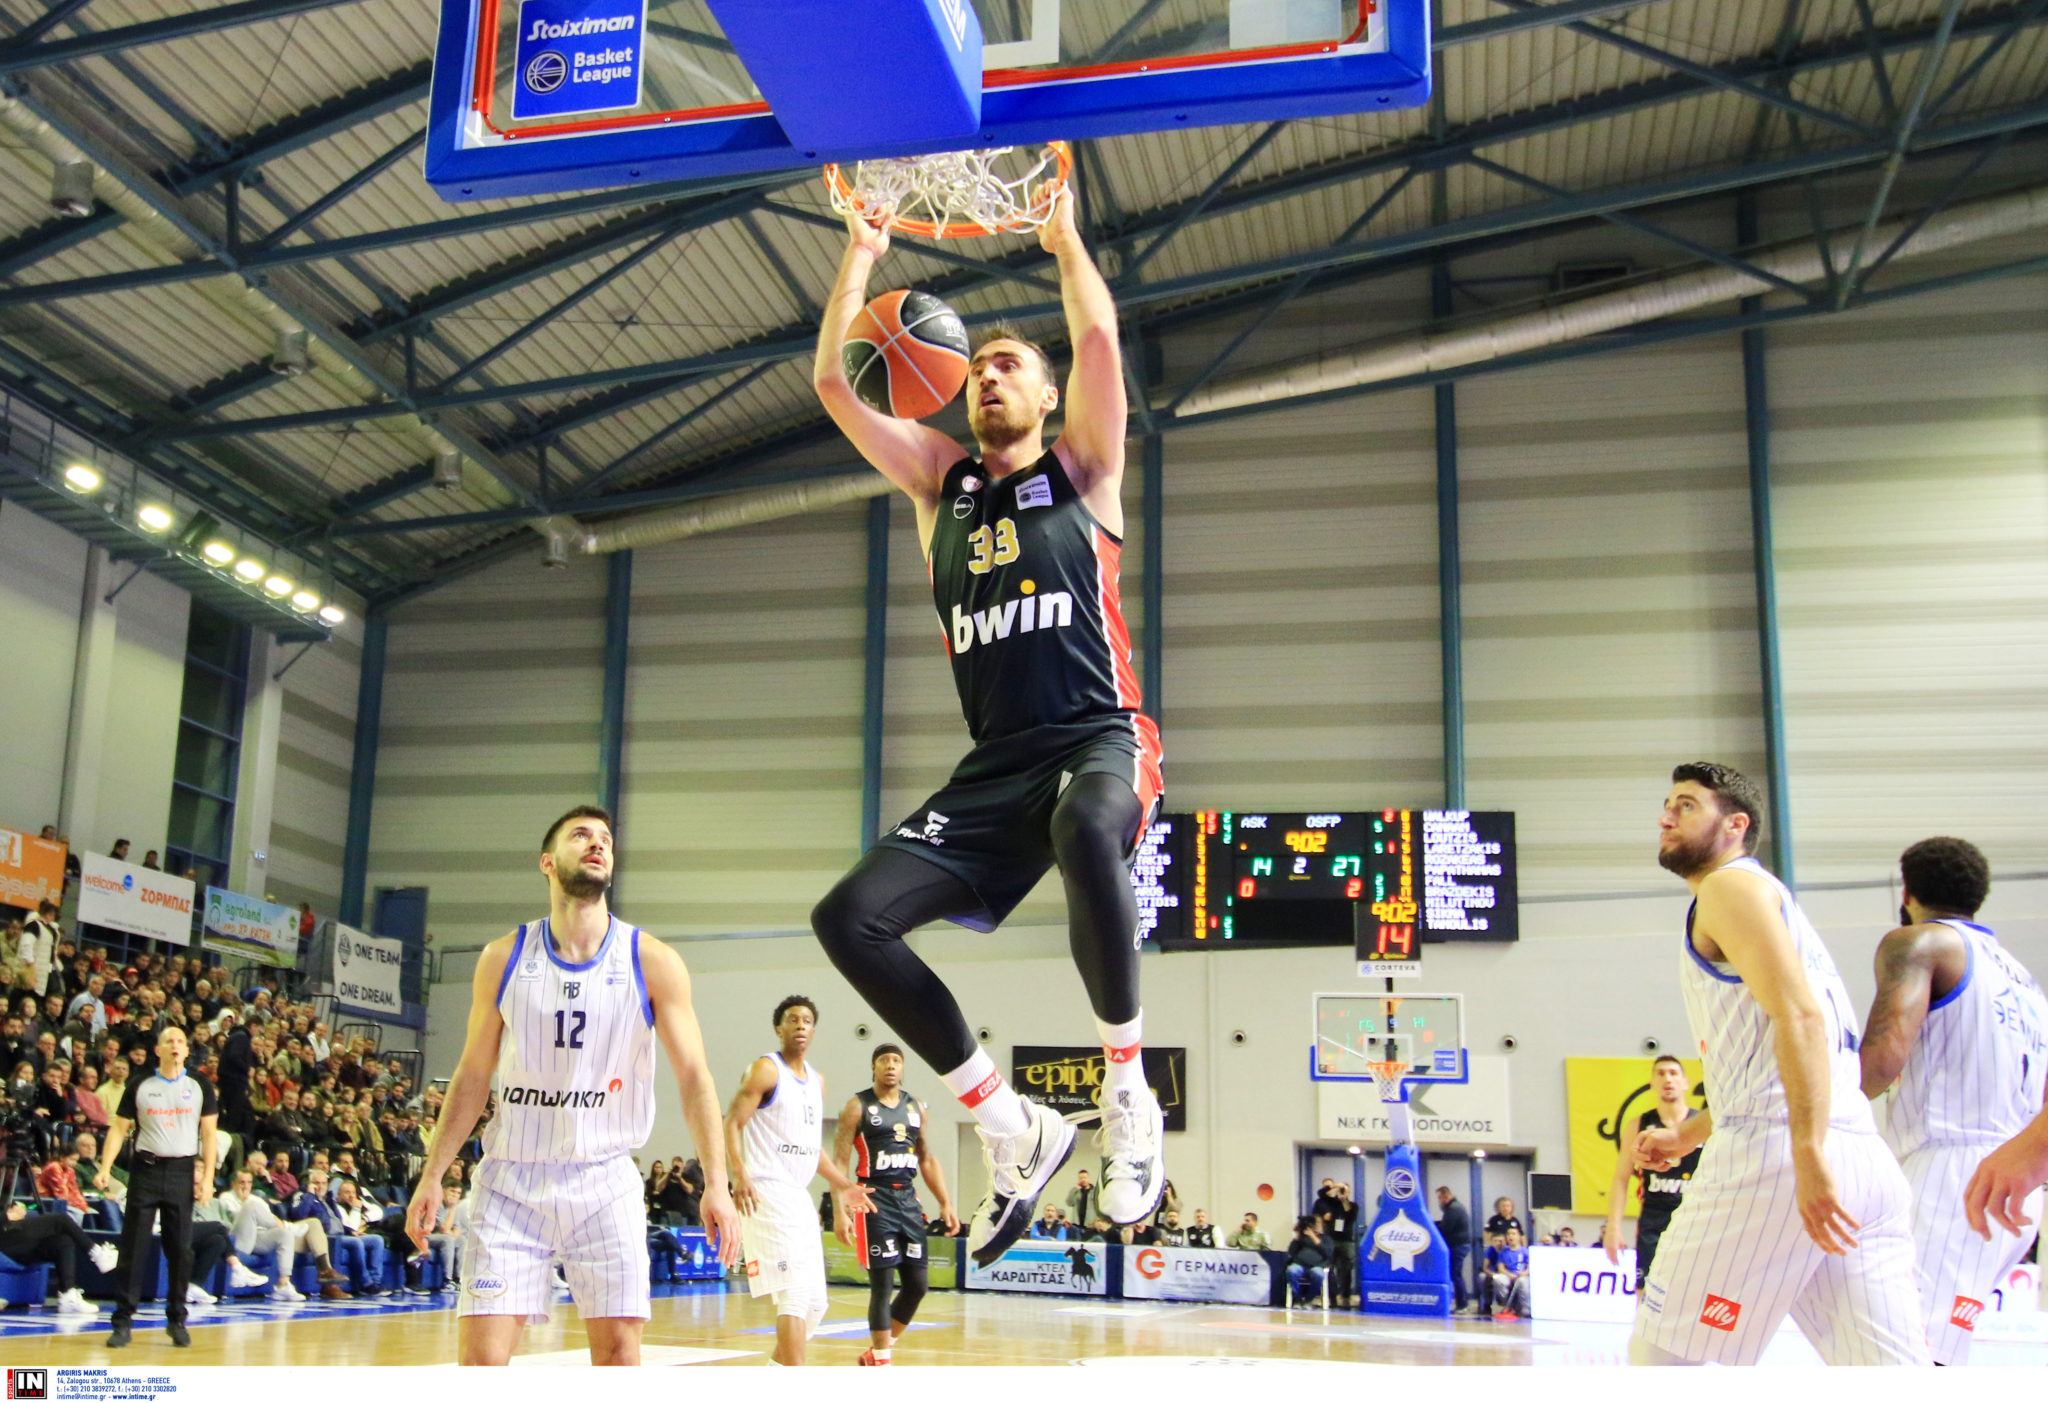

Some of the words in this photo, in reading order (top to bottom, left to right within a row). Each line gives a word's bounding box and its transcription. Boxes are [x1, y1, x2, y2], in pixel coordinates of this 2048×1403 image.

[527, 15, 635, 41] Stoiximan
[574, 47, 633, 67] Basket
[573, 66, 632, 84] League
[968, 517, 1020, 575] 33
[952, 579, 1073, 654] bwin
[1241, 816, 1268, 828] ASK
[1306, 815, 1342, 828] OSFP
[1252, 858, 1272, 876] 14
[1293, 857, 1307, 874] 2
[1332, 857, 1360, 876] 27
[84, 874, 125, 894] welcome
[1239, 879, 1255, 897] 0
[1346, 878, 1362, 898] 2
[141, 888, 191, 913] ΖΟΡΜΠΑΣ
[1377, 924, 1413, 954] 14
[355, 944, 373, 960] ONE
[375, 948, 400, 965] TEAM
[340, 982, 359, 999] ONE
[361, 987, 395, 1006] DREAM.
[555, 1010, 586, 1049] 12
[893, 1123, 906, 1142] 3
[1380, 1230, 1422, 1242] Attiki
[992, 1271, 1065, 1284] ΚΑΡΔΙΤΣΑΣ
[1036, 1263, 1066, 1273] ΚΤΕΛ
[1175, 1260, 1258, 1276] ΓΕΡΜΑΝΟΣ
[470, 1279, 503, 1289] Attiki
[1703, 1301, 1736, 1326] illy
